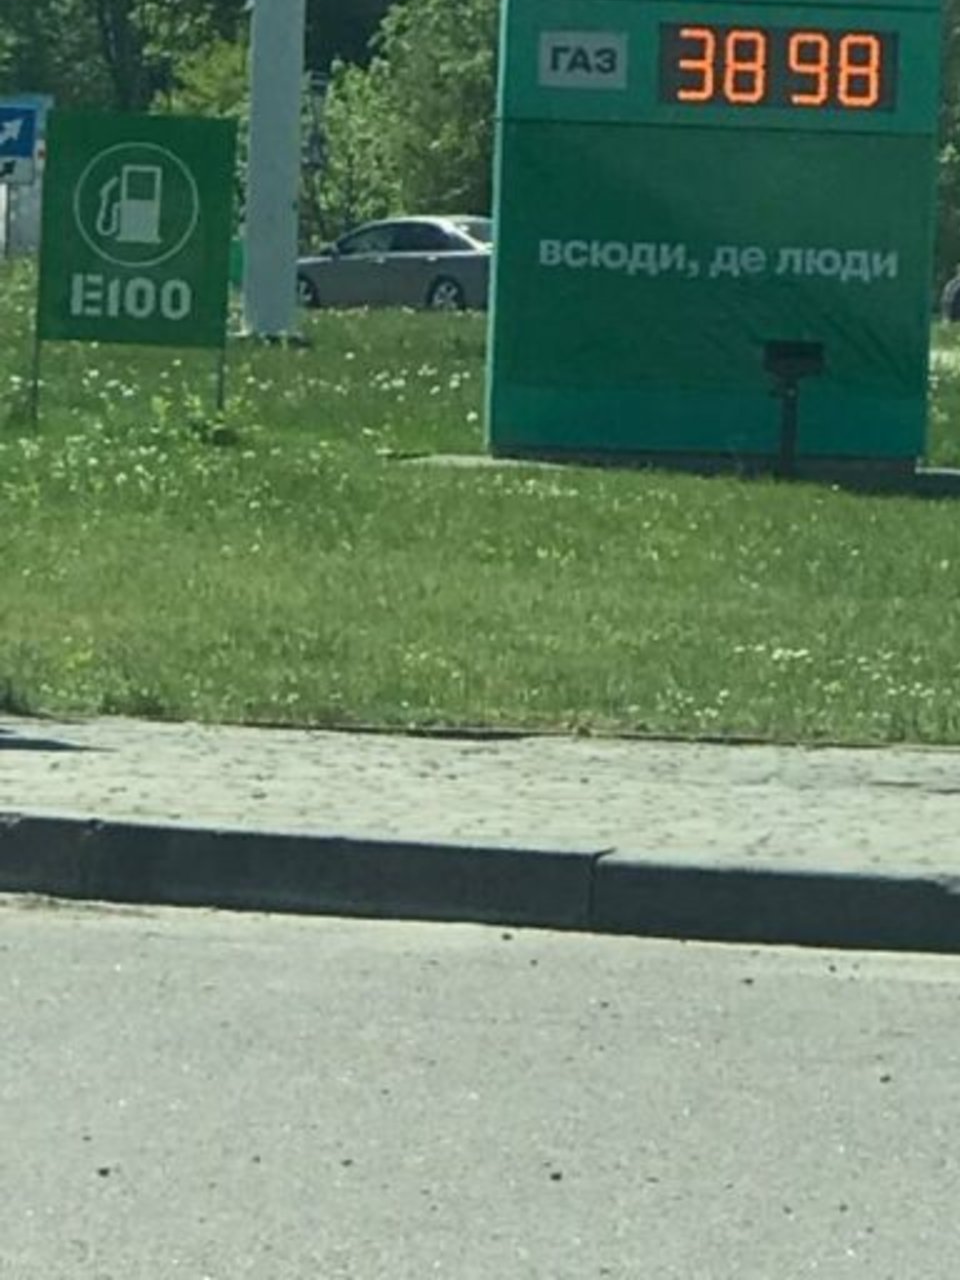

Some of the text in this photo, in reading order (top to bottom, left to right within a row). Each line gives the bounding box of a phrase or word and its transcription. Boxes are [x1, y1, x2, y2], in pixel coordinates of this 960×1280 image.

[549, 46, 618, 73] ГАЗ
[775, 247, 899, 282] люди
[69, 272, 193, 320] E100
